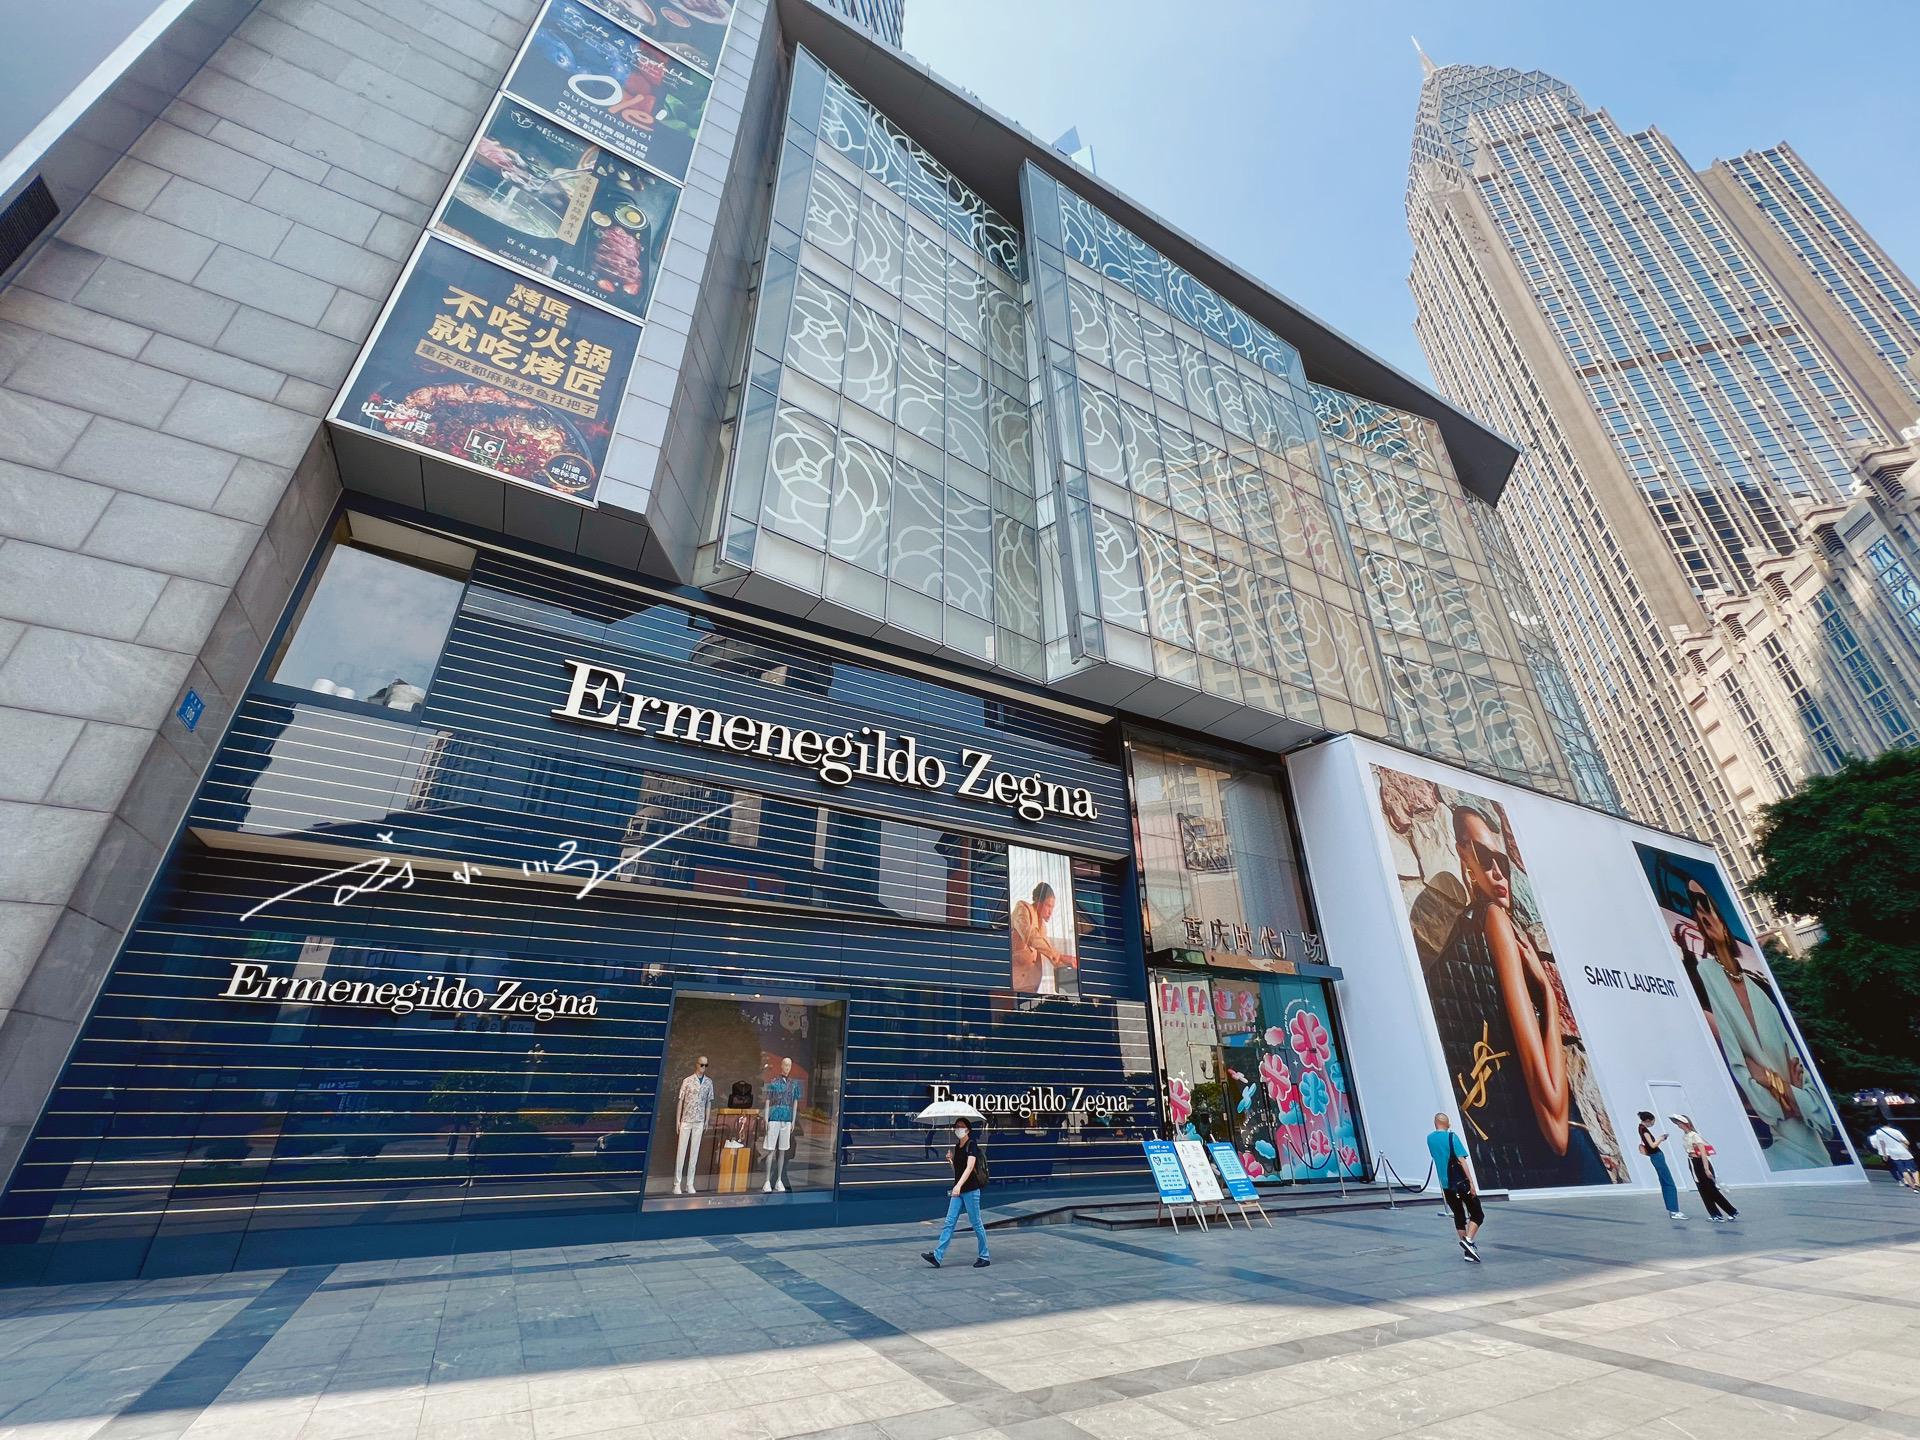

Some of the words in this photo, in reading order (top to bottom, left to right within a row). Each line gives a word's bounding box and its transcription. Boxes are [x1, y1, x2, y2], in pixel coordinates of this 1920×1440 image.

[563, 90, 653, 141] supermarket
[510, 283, 572, 321] 烤匠
[442, 285, 613, 374] 不吃火锅
[418, 343, 596, 415] 重庆成都麻辣烤鱼扛把子
[427, 314, 606, 400] 就吃烤匠
[470, 435, 499, 453] L6
[551, 659, 946, 788] Ermenegildo
[957, 748, 1098, 822] Zegna
[1181, 916, 1325, 964] 重庆时代广场
[218, 962, 484, 1015] Ermenegildo
[489, 980, 599, 1022] Zegna
[1584, 965, 1624, 989] SAINT
[1623, 971, 1679, 998] LAURENT
[1071, 1087, 1131, 1118] Zegna
